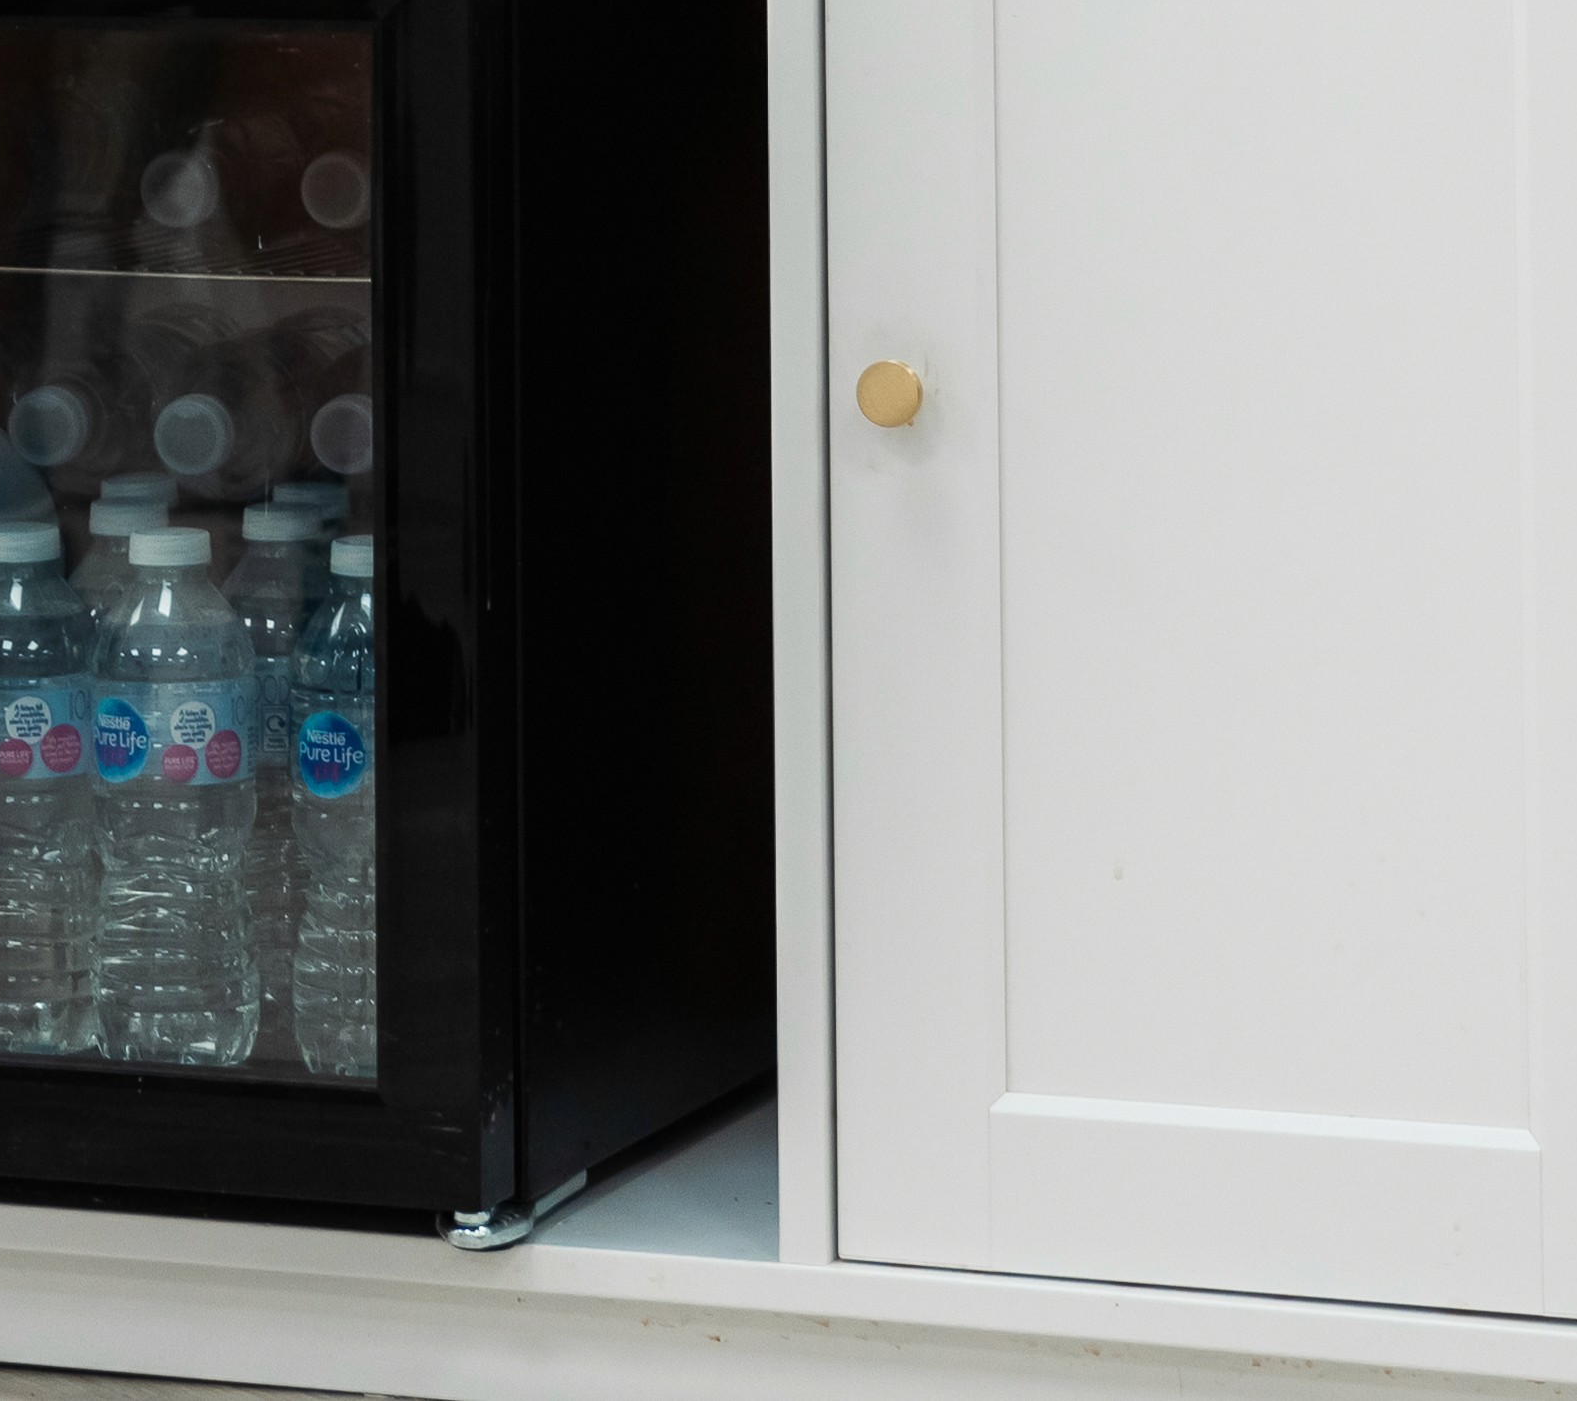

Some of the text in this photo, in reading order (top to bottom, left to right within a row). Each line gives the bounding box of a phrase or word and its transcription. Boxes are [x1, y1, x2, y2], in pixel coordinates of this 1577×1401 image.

[119, 730, 147, 756] Life
[299, 741, 331, 763] Pure
[334, 746, 364, 772] Life
